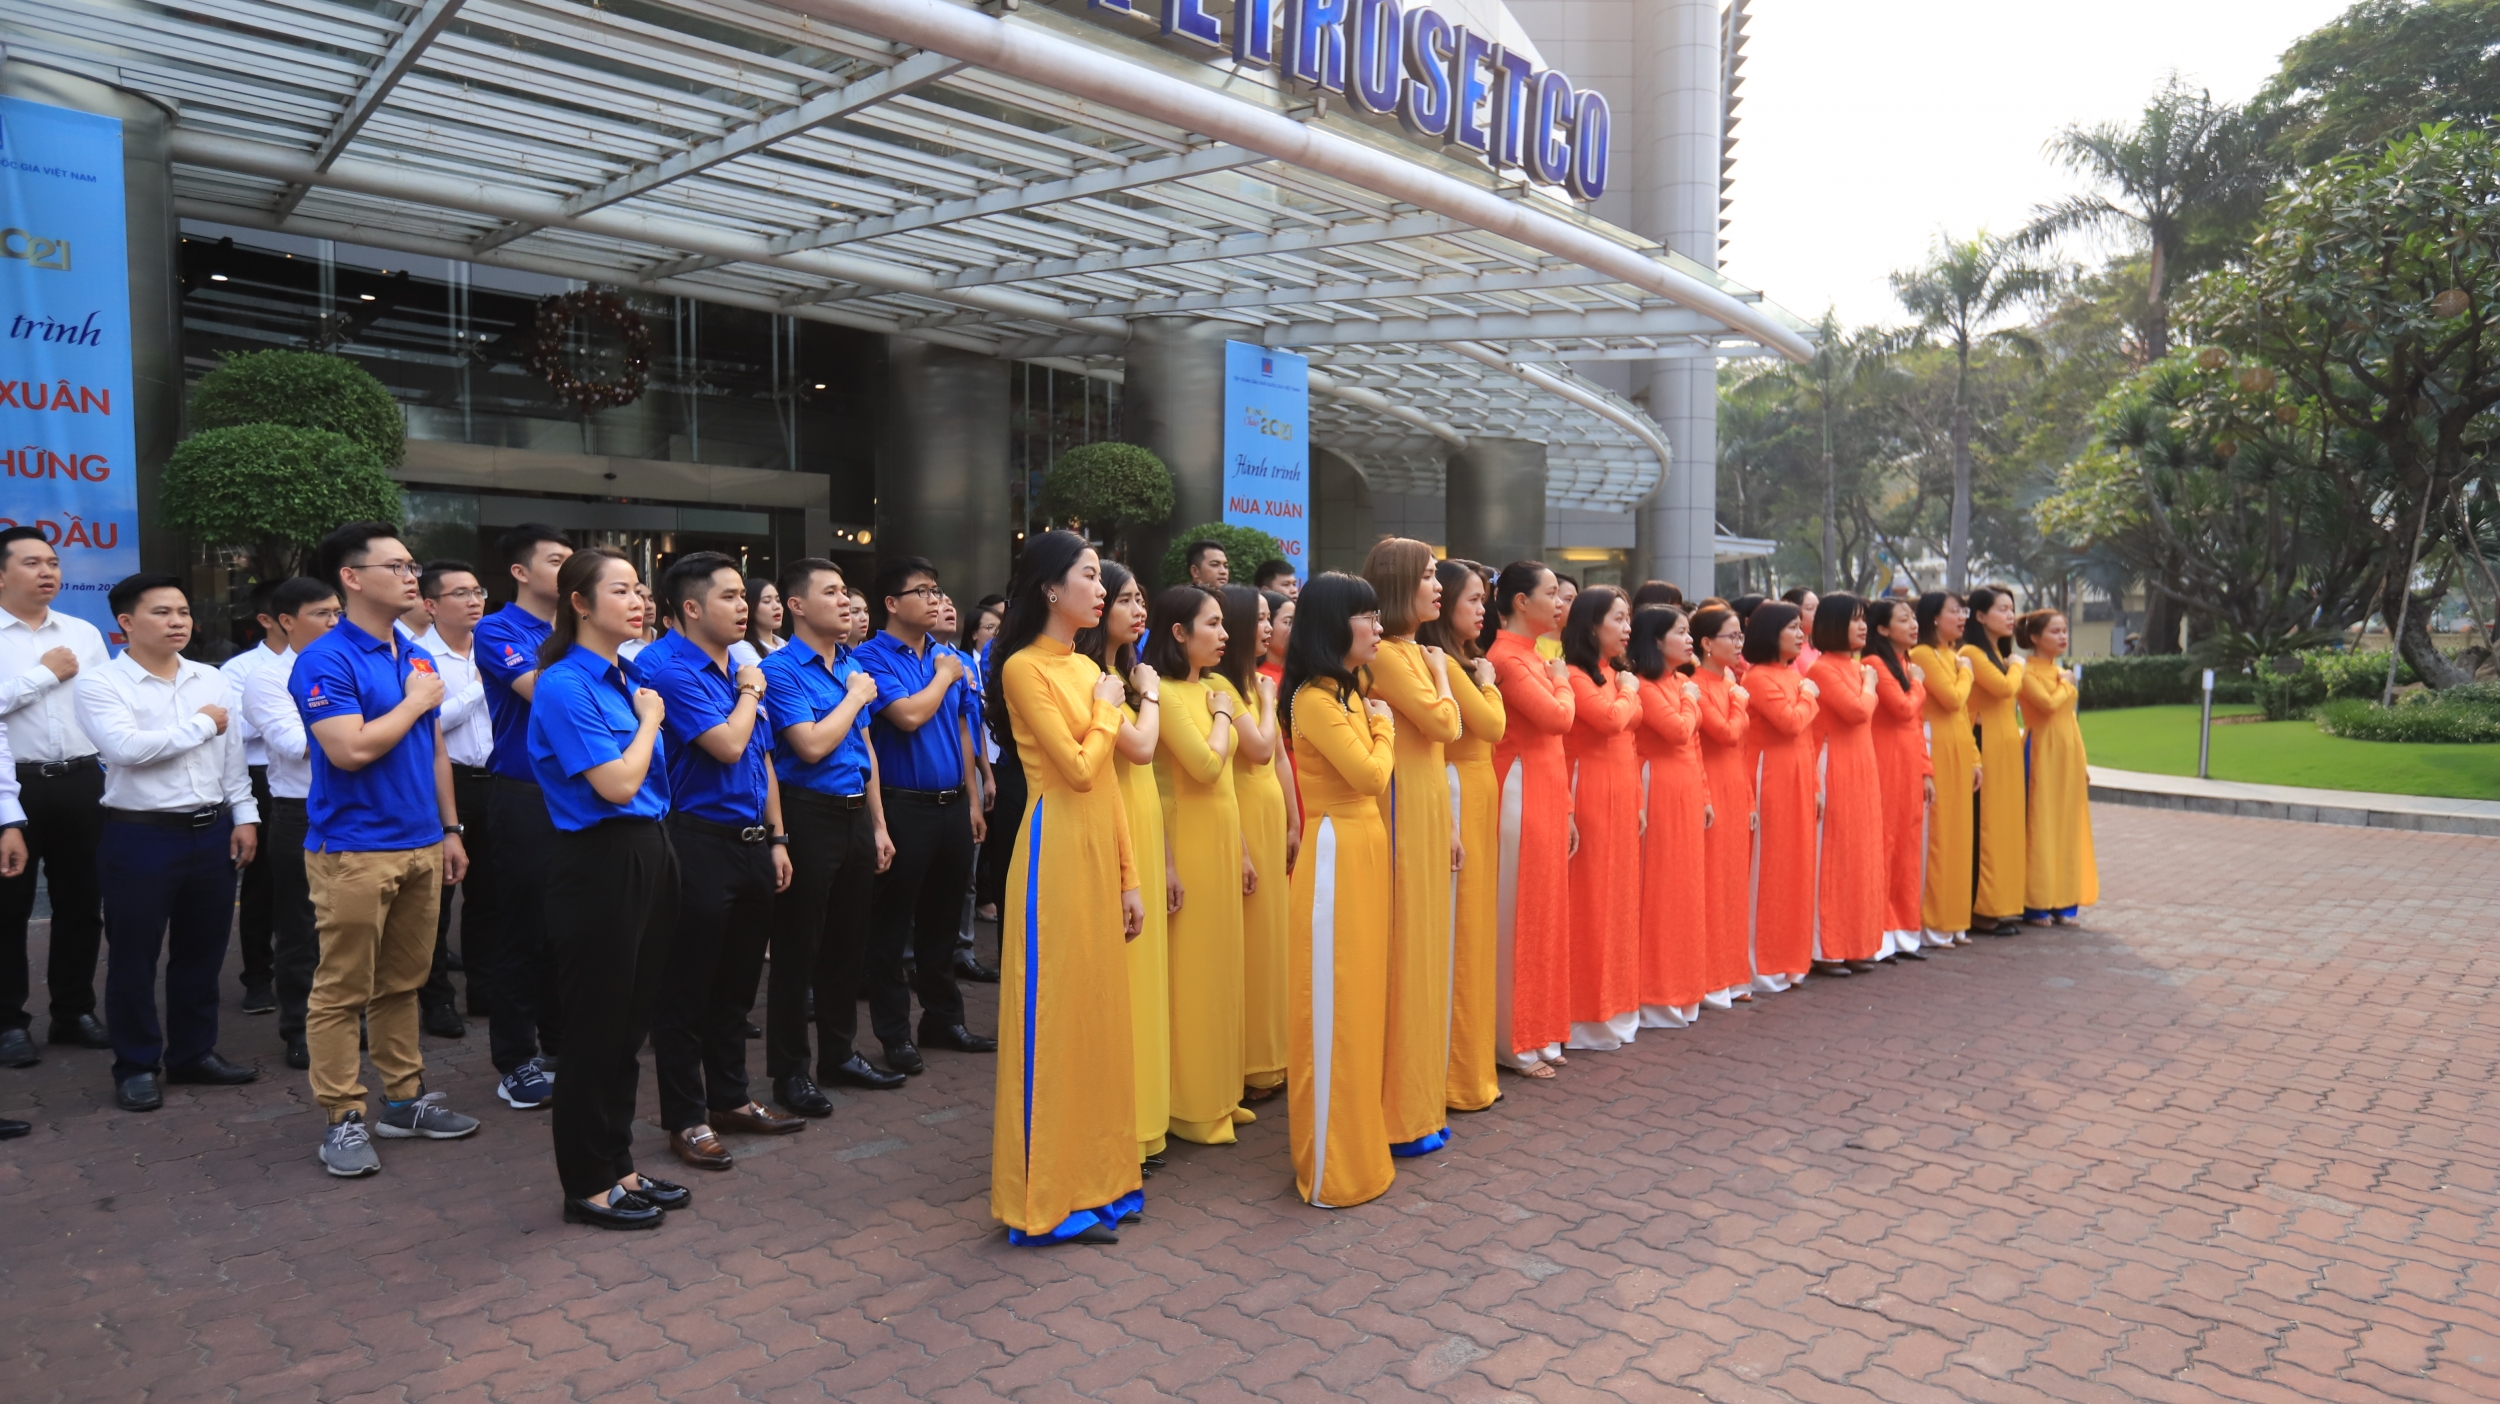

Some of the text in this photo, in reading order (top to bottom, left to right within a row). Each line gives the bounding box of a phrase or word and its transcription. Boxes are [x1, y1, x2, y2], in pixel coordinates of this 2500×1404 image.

[1088, 0, 1610, 202] ROSETCO
[0, 157, 97, 183] ỐC GIA VIỆT NAM
[0, 227, 71, 272] 021
[10, 310, 102, 347] trình
[0, 379, 110, 416] XUÂN
[1261, 418, 1292, 441] 2021
[1232, 454, 1300, 481] Hành trình
[1229, 494, 1302, 518] MÙA XUÂN
[35, 511, 118, 549] DẦU
[72, 582, 95, 591] năm
